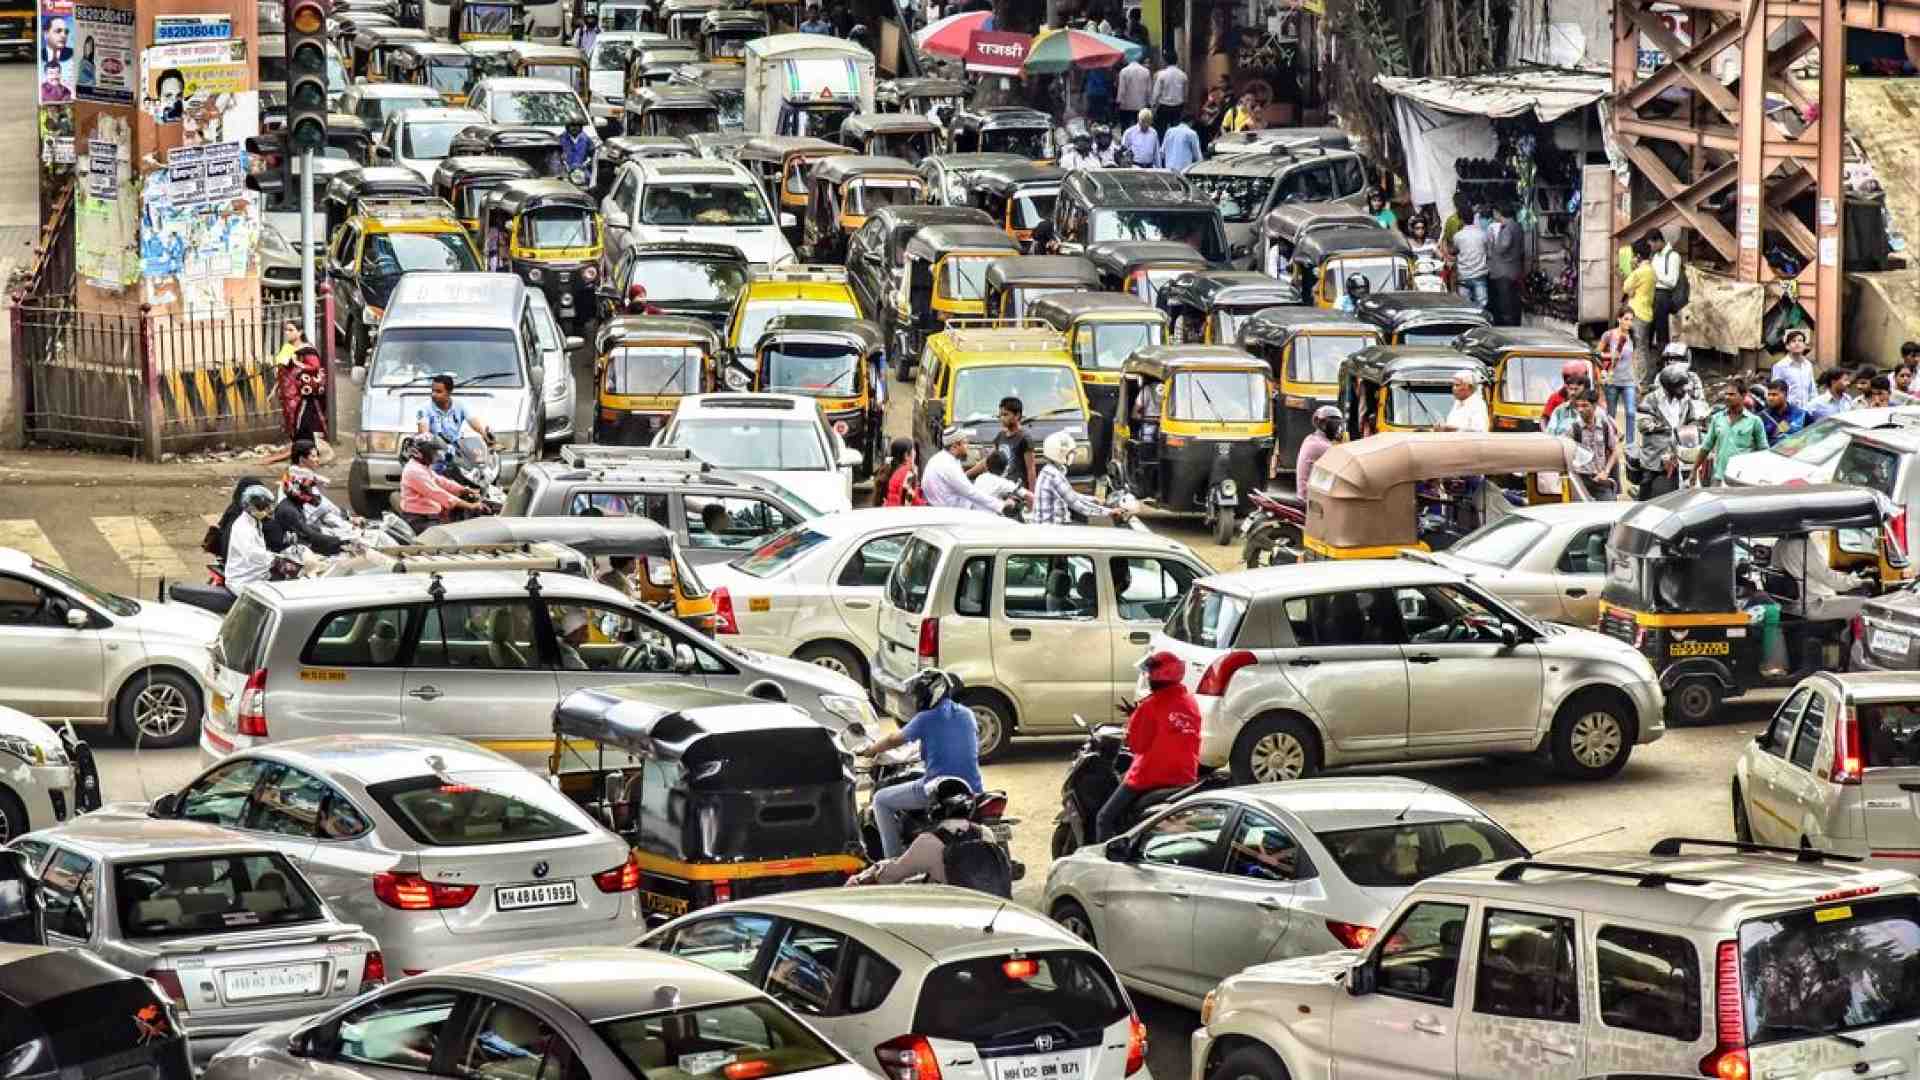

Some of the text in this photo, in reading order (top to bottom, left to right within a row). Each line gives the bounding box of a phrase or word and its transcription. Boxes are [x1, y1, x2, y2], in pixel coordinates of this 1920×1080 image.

[159, 24, 229, 37] 9820360417
[976, 42, 1024, 58] राजश्री
[501, 891, 515, 905] MH
[1004, 1068, 1020, 1080] MH
[1023, 1066, 1038, 1079] 02
